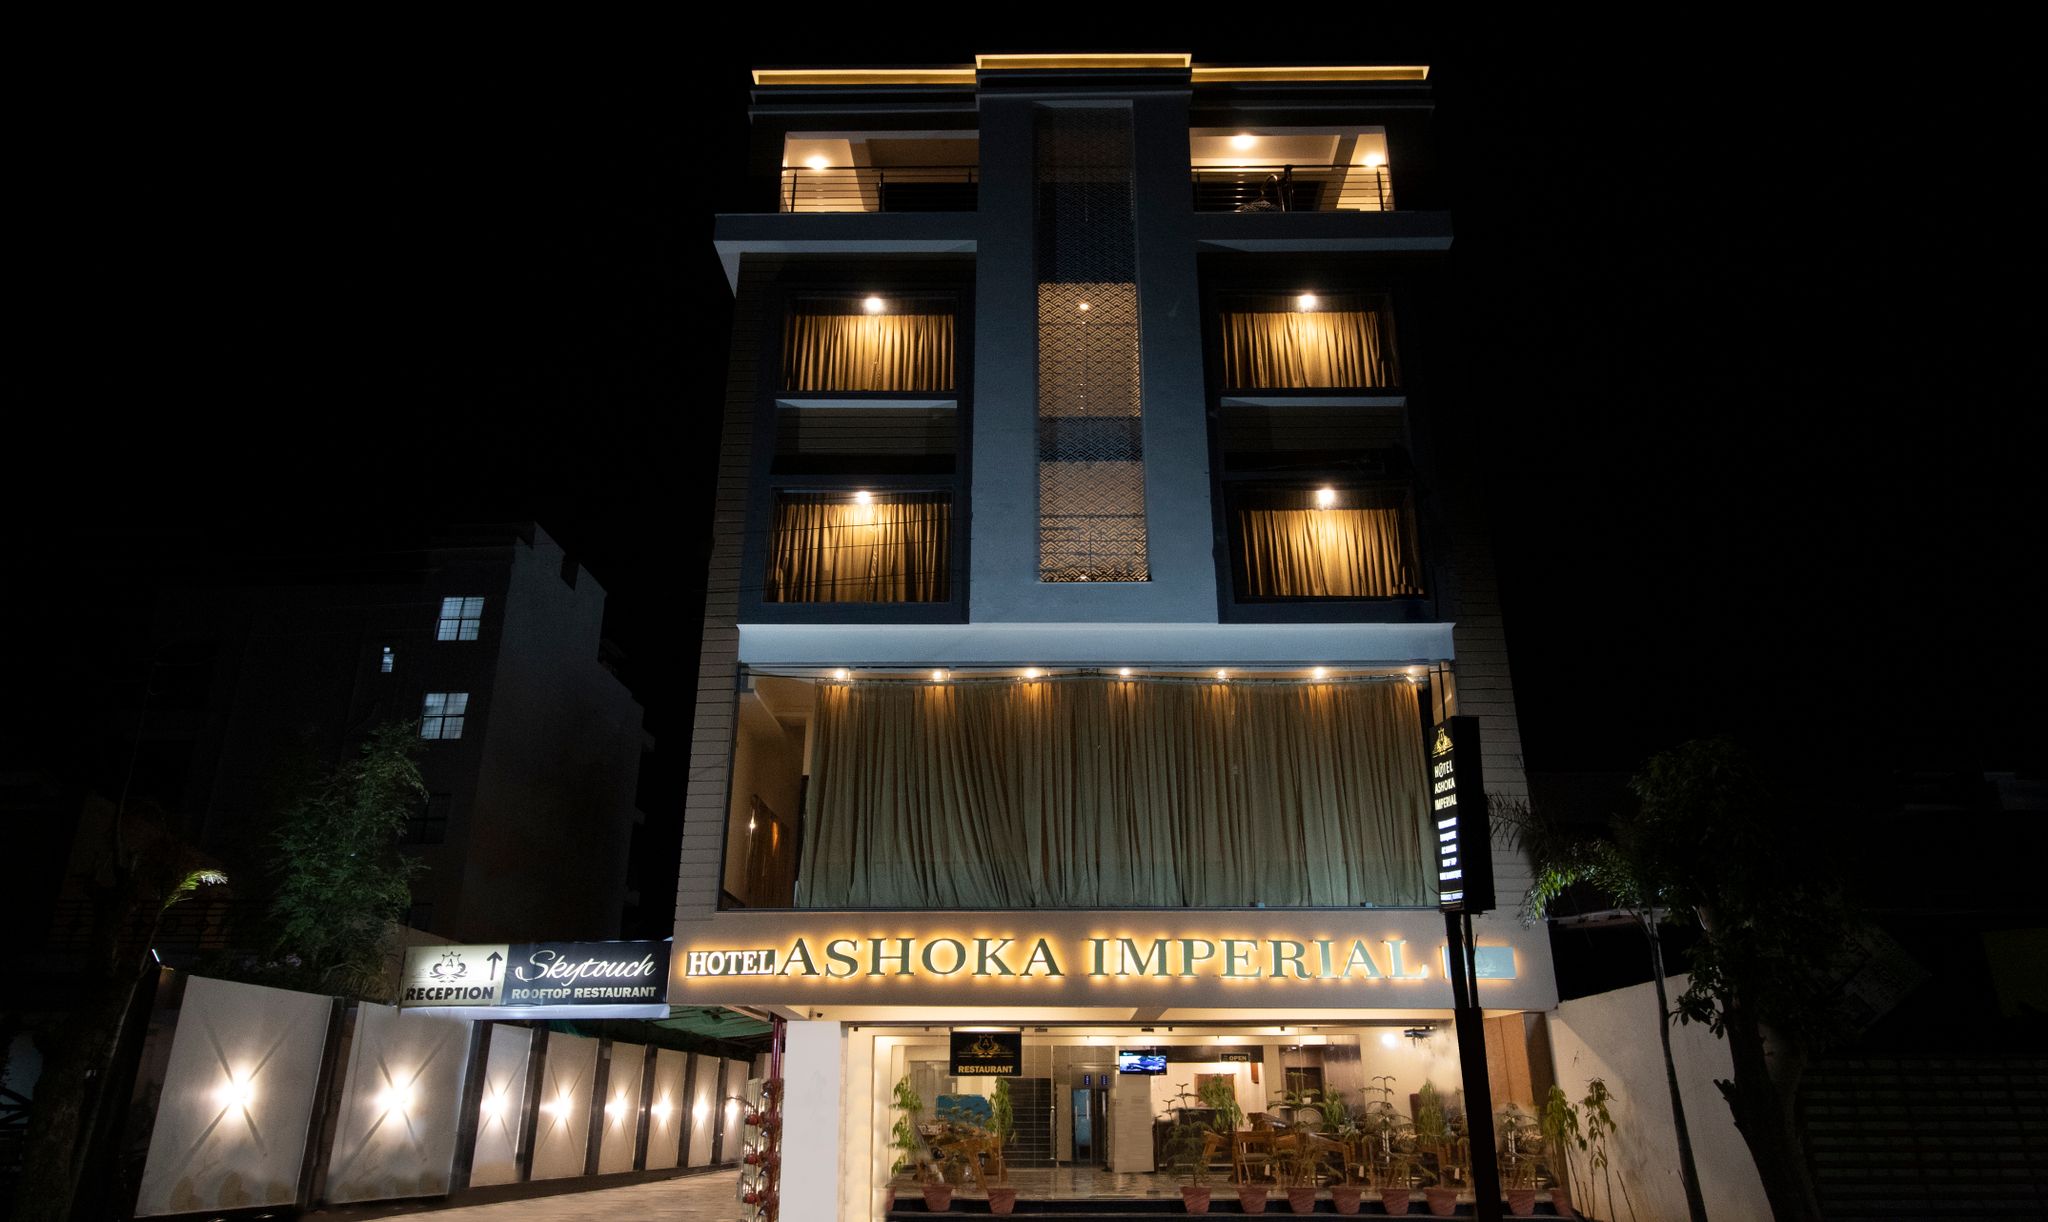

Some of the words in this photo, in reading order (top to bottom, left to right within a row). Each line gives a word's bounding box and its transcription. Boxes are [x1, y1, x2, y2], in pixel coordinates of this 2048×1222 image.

[1434, 760, 1453, 778] HOTEL
[1435, 777, 1456, 795] ASHOKA
[1435, 794, 1457, 811] IMPERIAL
[688, 951, 774, 975] HOTEL
[776, 937, 1064, 979] ASHOKA
[1088, 937, 1428, 980] IMPERIAL
[515, 950, 656, 987] Skytouch
[405, 986, 495, 1001] RECEPTION
[512, 988, 571, 999] ROOFTOP
[573, 986, 656, 999] RESTAURANT
[958, 1065, 1014, 1074] RESTAURANT
